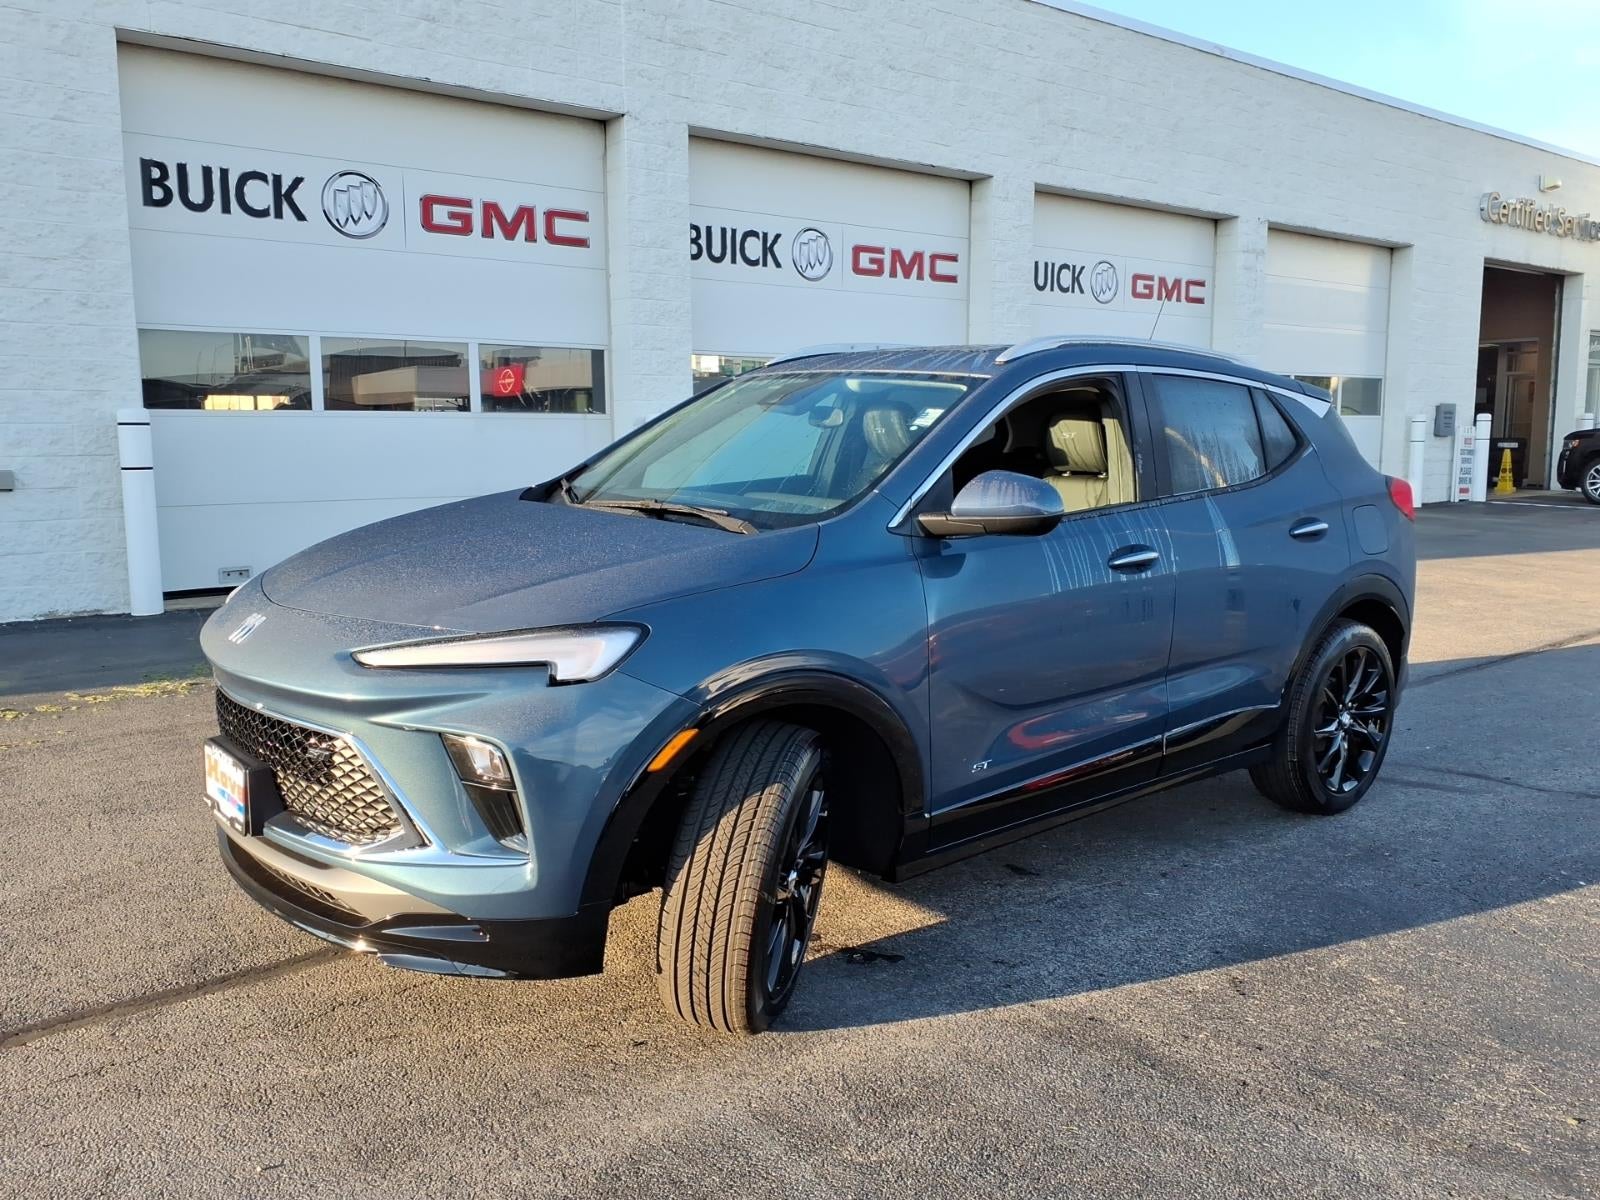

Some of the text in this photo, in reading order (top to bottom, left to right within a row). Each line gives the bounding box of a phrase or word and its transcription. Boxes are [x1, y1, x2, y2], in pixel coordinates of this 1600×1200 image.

[139, 157, 308, 222] BUICK
[419, 193, 590, 248] GMC
[1480, 191, 1554, 235] Certified
[690, 223, 783, 269] BUICK
[851, 244, 959, 284] GMC
[1033, 260, 1085, 295] UICK
[1131, 272, 1206, 305] GMC
[971, 759, 992, 773] ST
